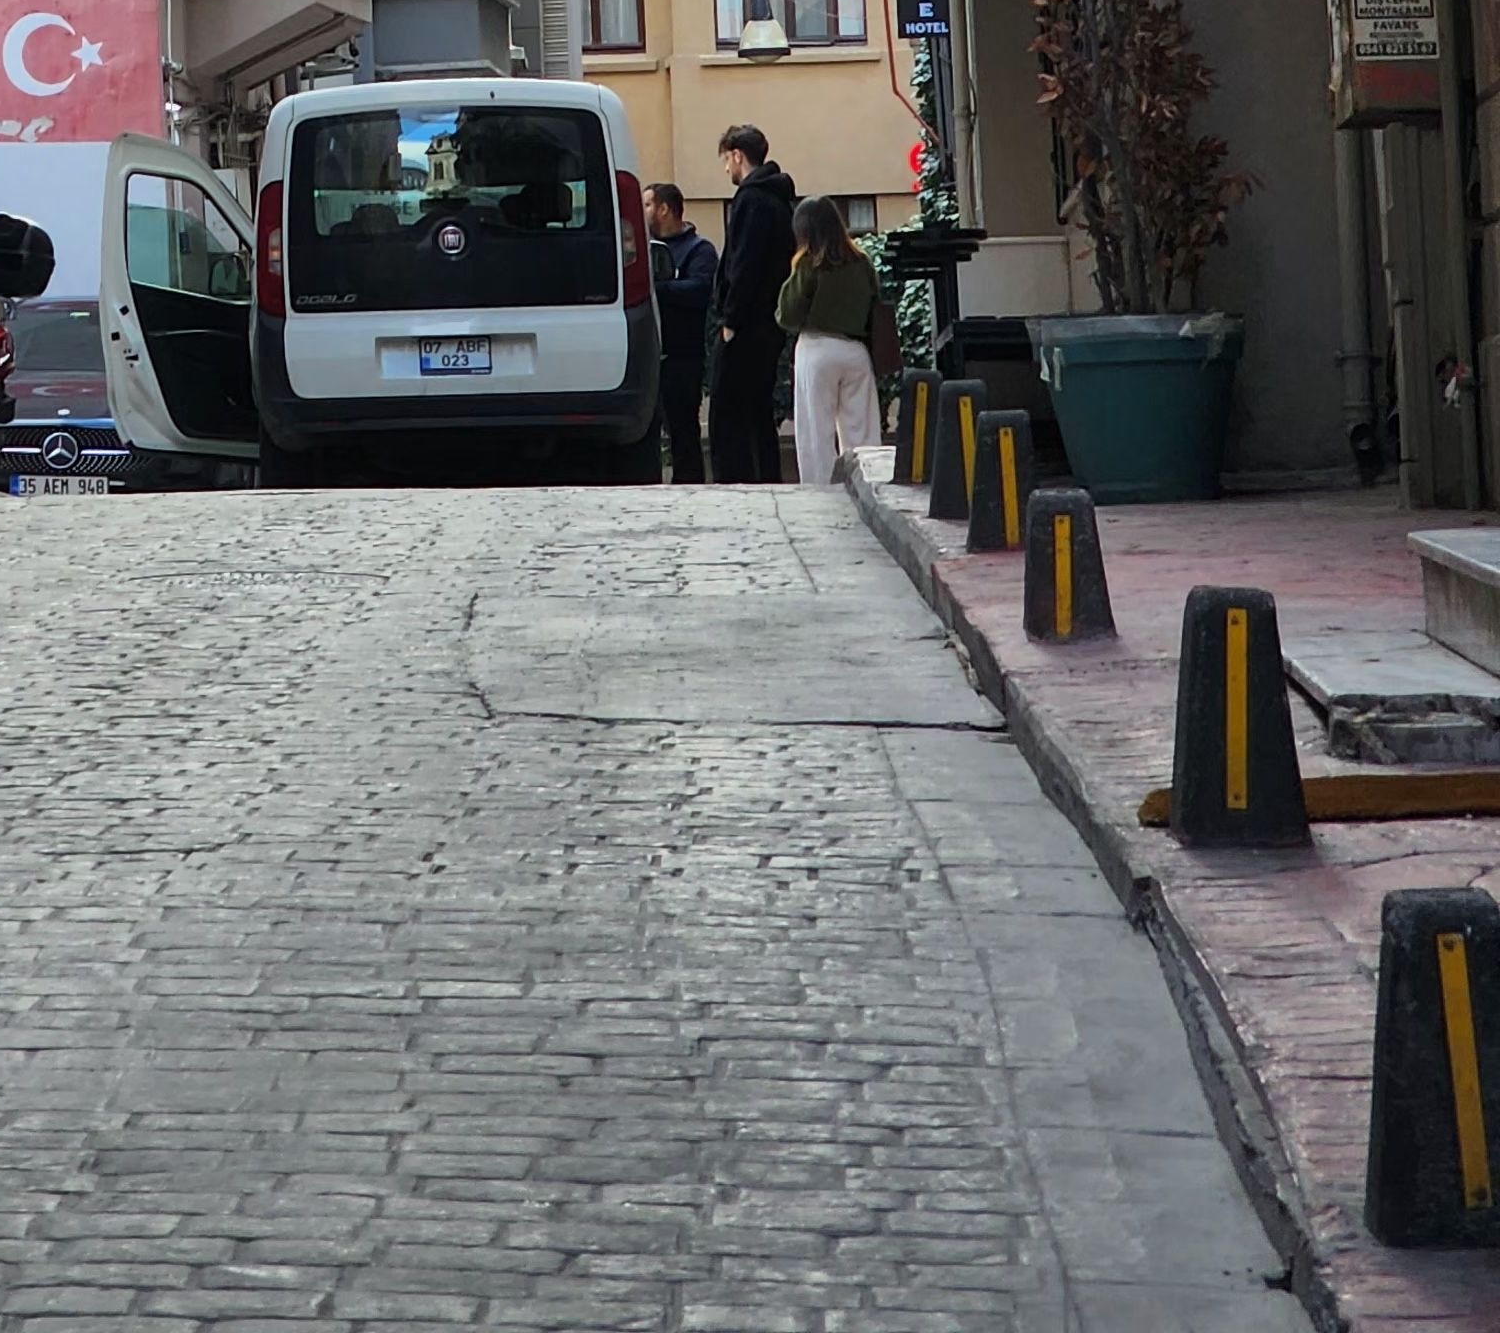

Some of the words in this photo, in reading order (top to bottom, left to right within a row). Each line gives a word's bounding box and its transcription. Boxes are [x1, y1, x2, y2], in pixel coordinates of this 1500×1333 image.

[905, 22, 949, 35] HOTEL
[1373, 20, 1419, 31] FAYANS
[423, 340, 442, 354] 07
[456, 339, 486, 353] ABF
[441, 354, 469, 367] 023
[19, 478, 36, 494] 35
[43, 478, 69, 495] AEM
[78, 479, 105, 495] 948
